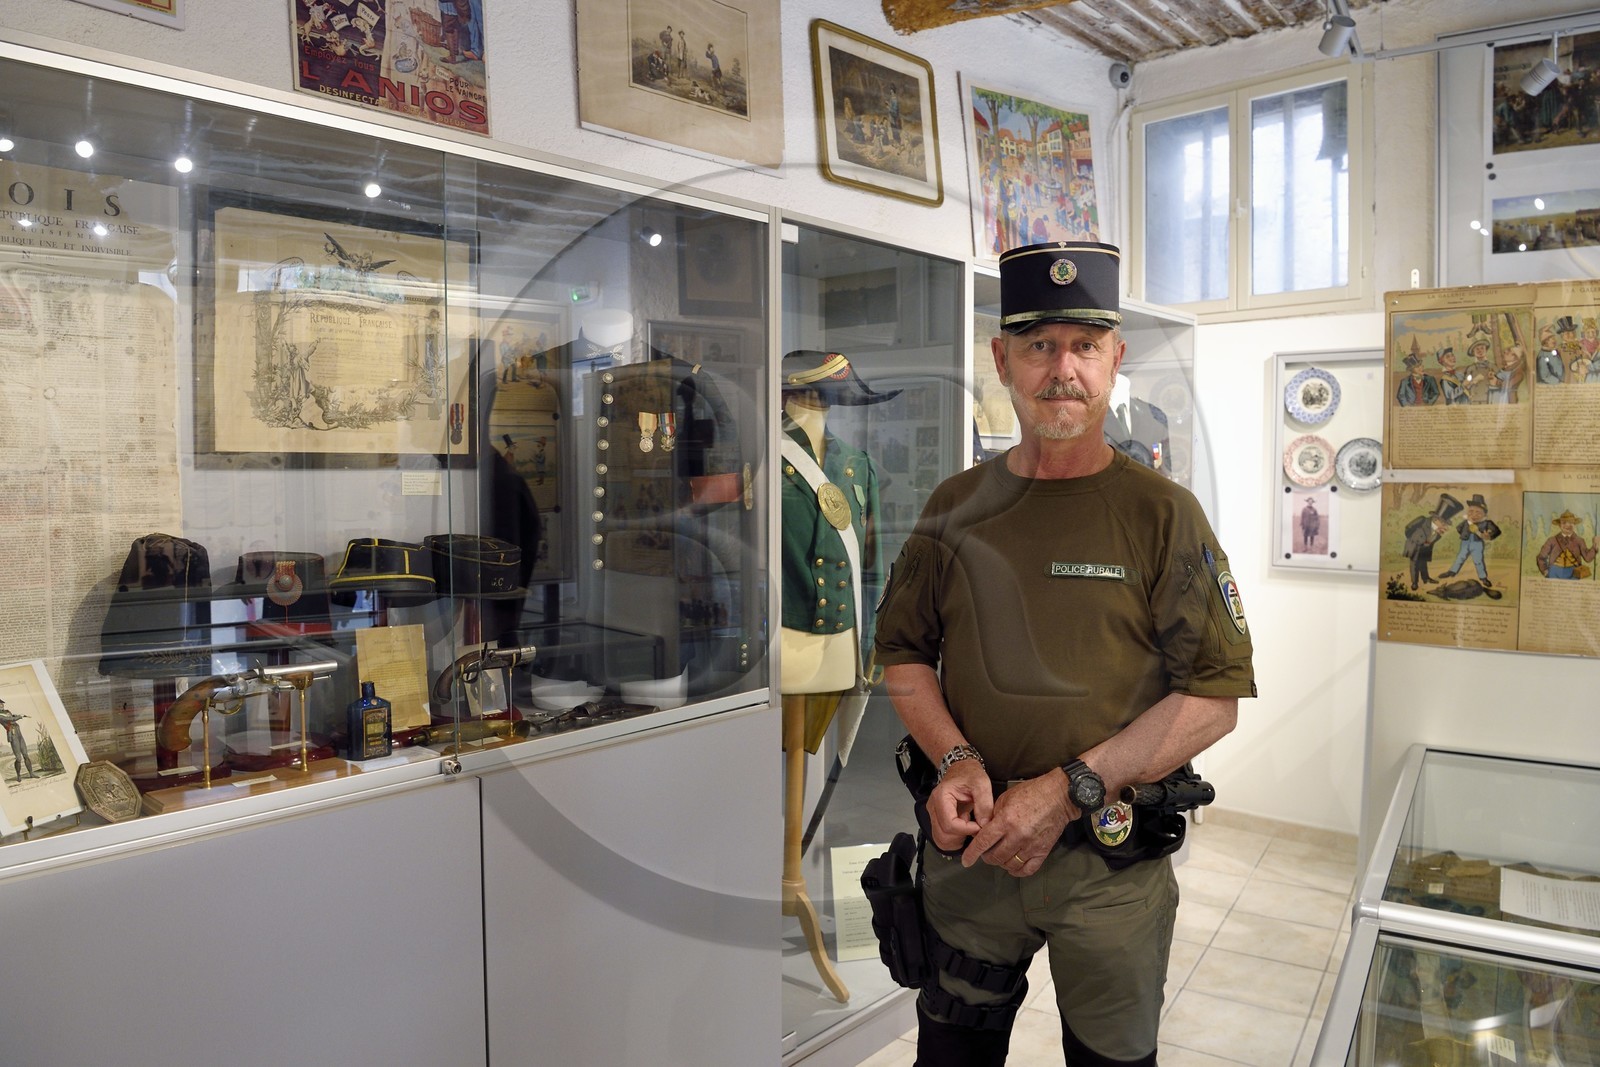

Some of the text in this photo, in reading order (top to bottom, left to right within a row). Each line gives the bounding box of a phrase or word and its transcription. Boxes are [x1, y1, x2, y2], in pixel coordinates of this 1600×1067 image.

[304, 45, 347, 65] Employez
[450, 77, 470, 90] POUR
[446, 85, 486, 102] LE VAINCRE
[63, 242, 75, 250] ET
[81, 245, 131, 256] INDIVISIBLE
[1055, 565, 1120, 575] POLICE RURALE
